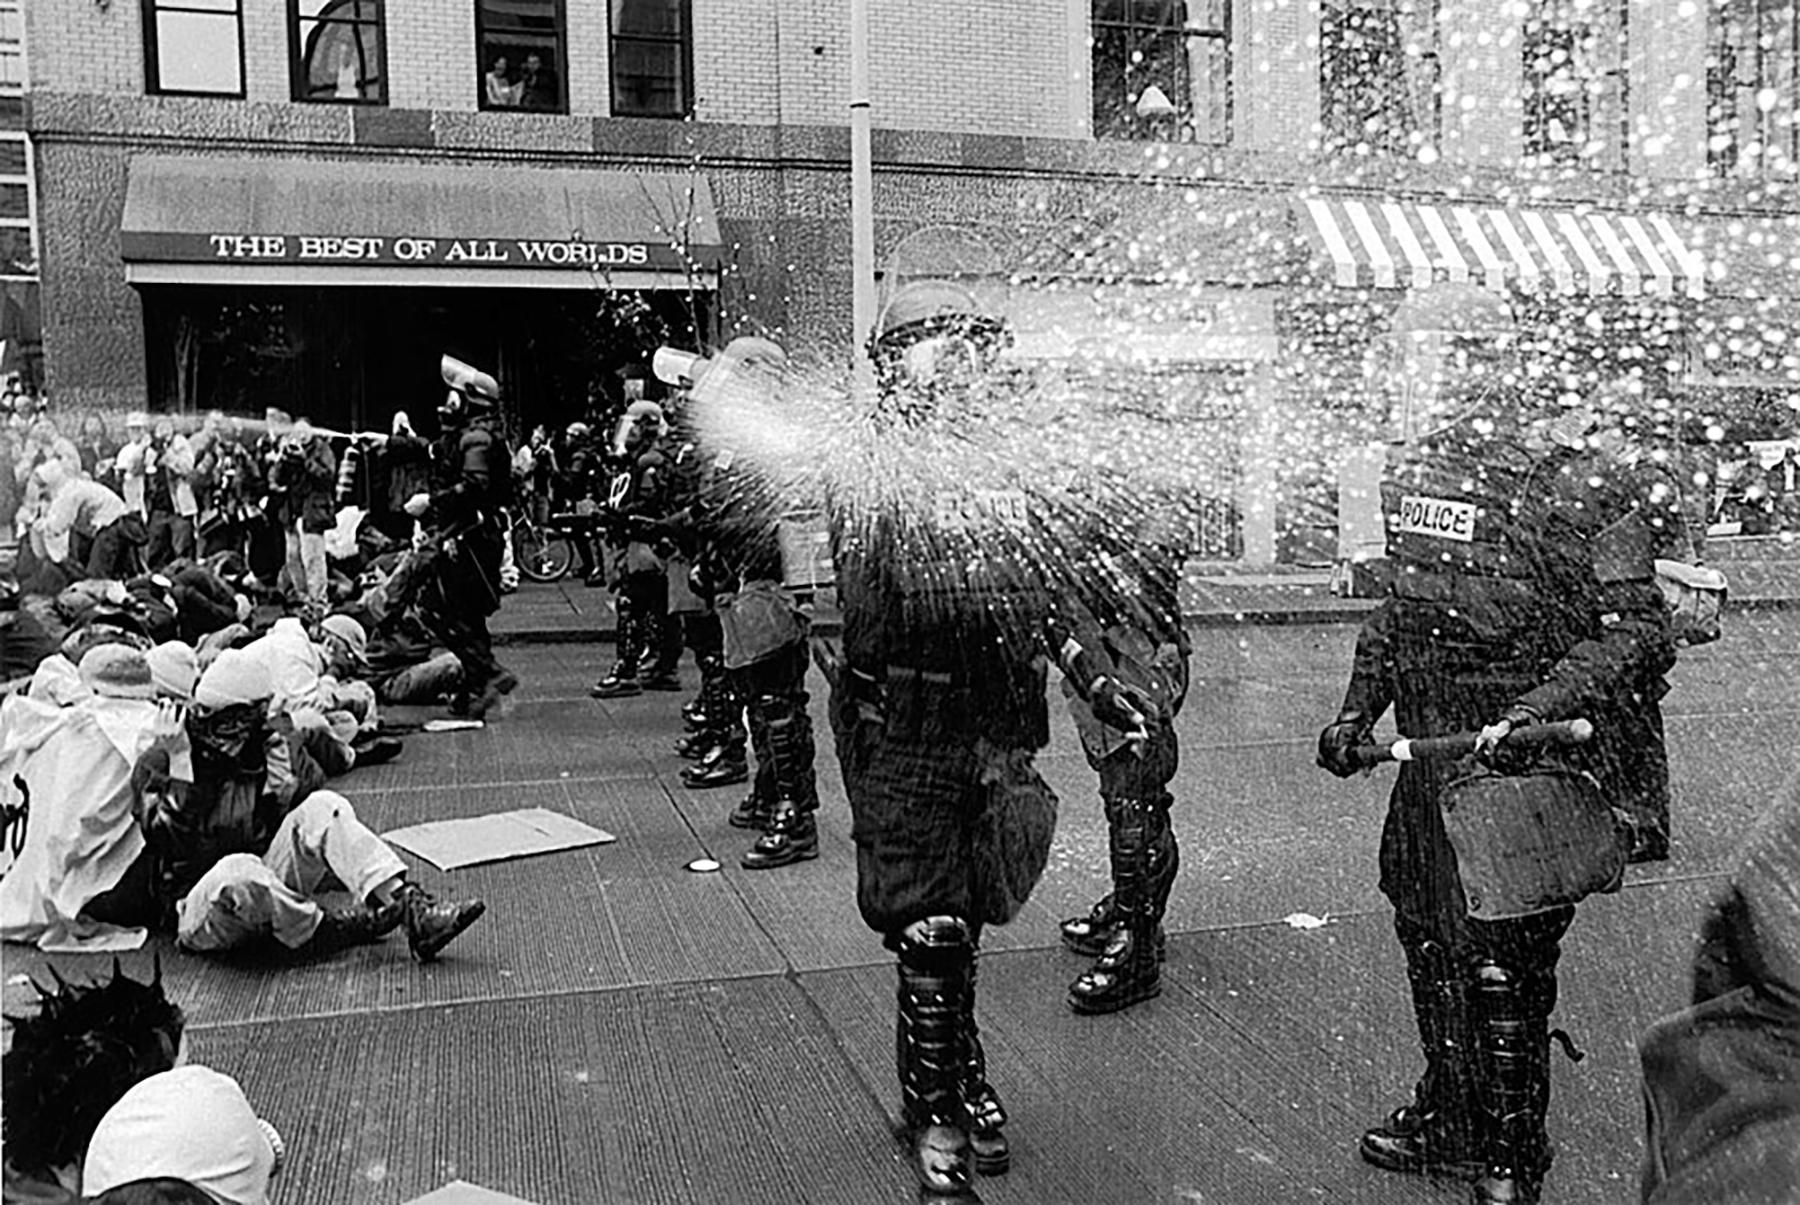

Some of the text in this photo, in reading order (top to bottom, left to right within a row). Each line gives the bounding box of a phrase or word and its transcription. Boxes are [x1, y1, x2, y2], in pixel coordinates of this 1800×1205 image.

[210, 235, 647, 264] THE BEST OF ALL WORLDS
[1402, 502, 1469, 534] POLICE
